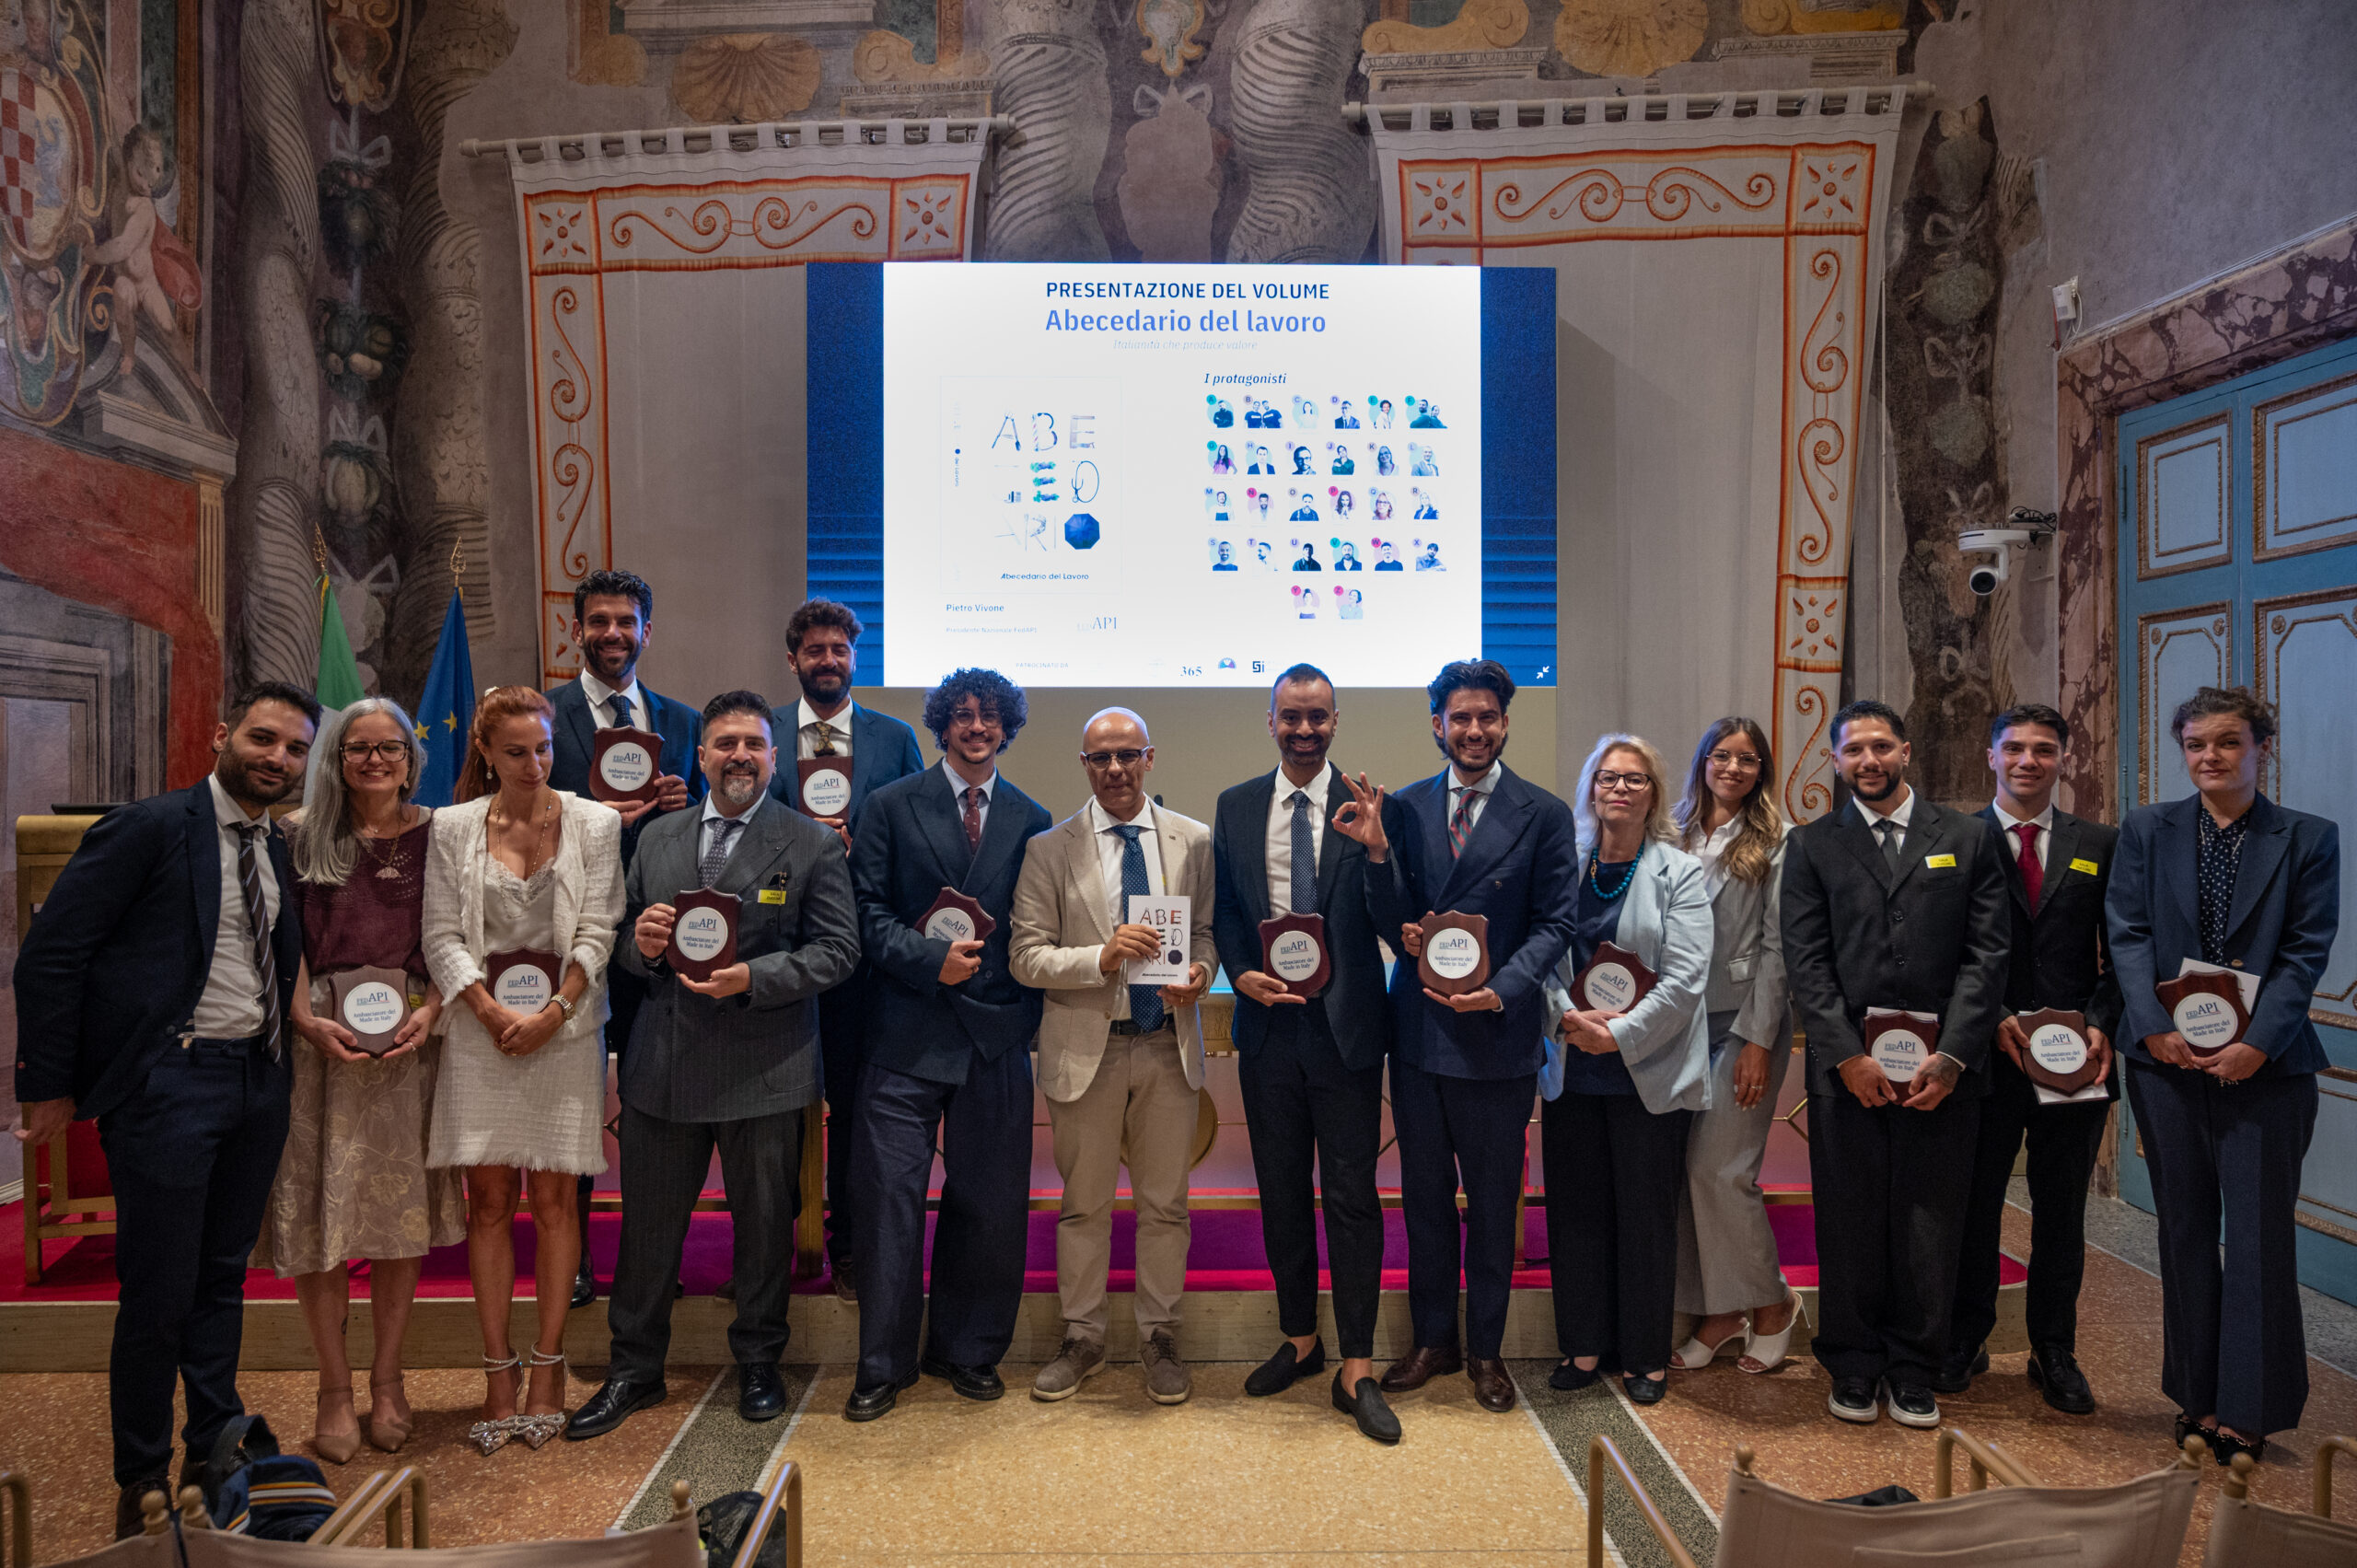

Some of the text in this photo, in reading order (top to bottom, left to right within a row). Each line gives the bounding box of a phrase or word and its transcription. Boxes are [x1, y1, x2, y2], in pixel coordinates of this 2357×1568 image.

[1046, 282, 1329, 299] PRESENTAZIONE DEL VOLUME
[1045, 308, 1326, 332] Abecedario del lavoro
[1113, 339, 1258, 352] Italianità che produce valore
[1204, 372, 1287, 386] I protagonisti
[992, 410, 1095, 451] ABE
[994, 460, 1100, 503] ED
[1180, 666, 1202, 676] 365
[1140, 907, 1181, 925] ABE
[1156, 928, 1183, 946] ED
